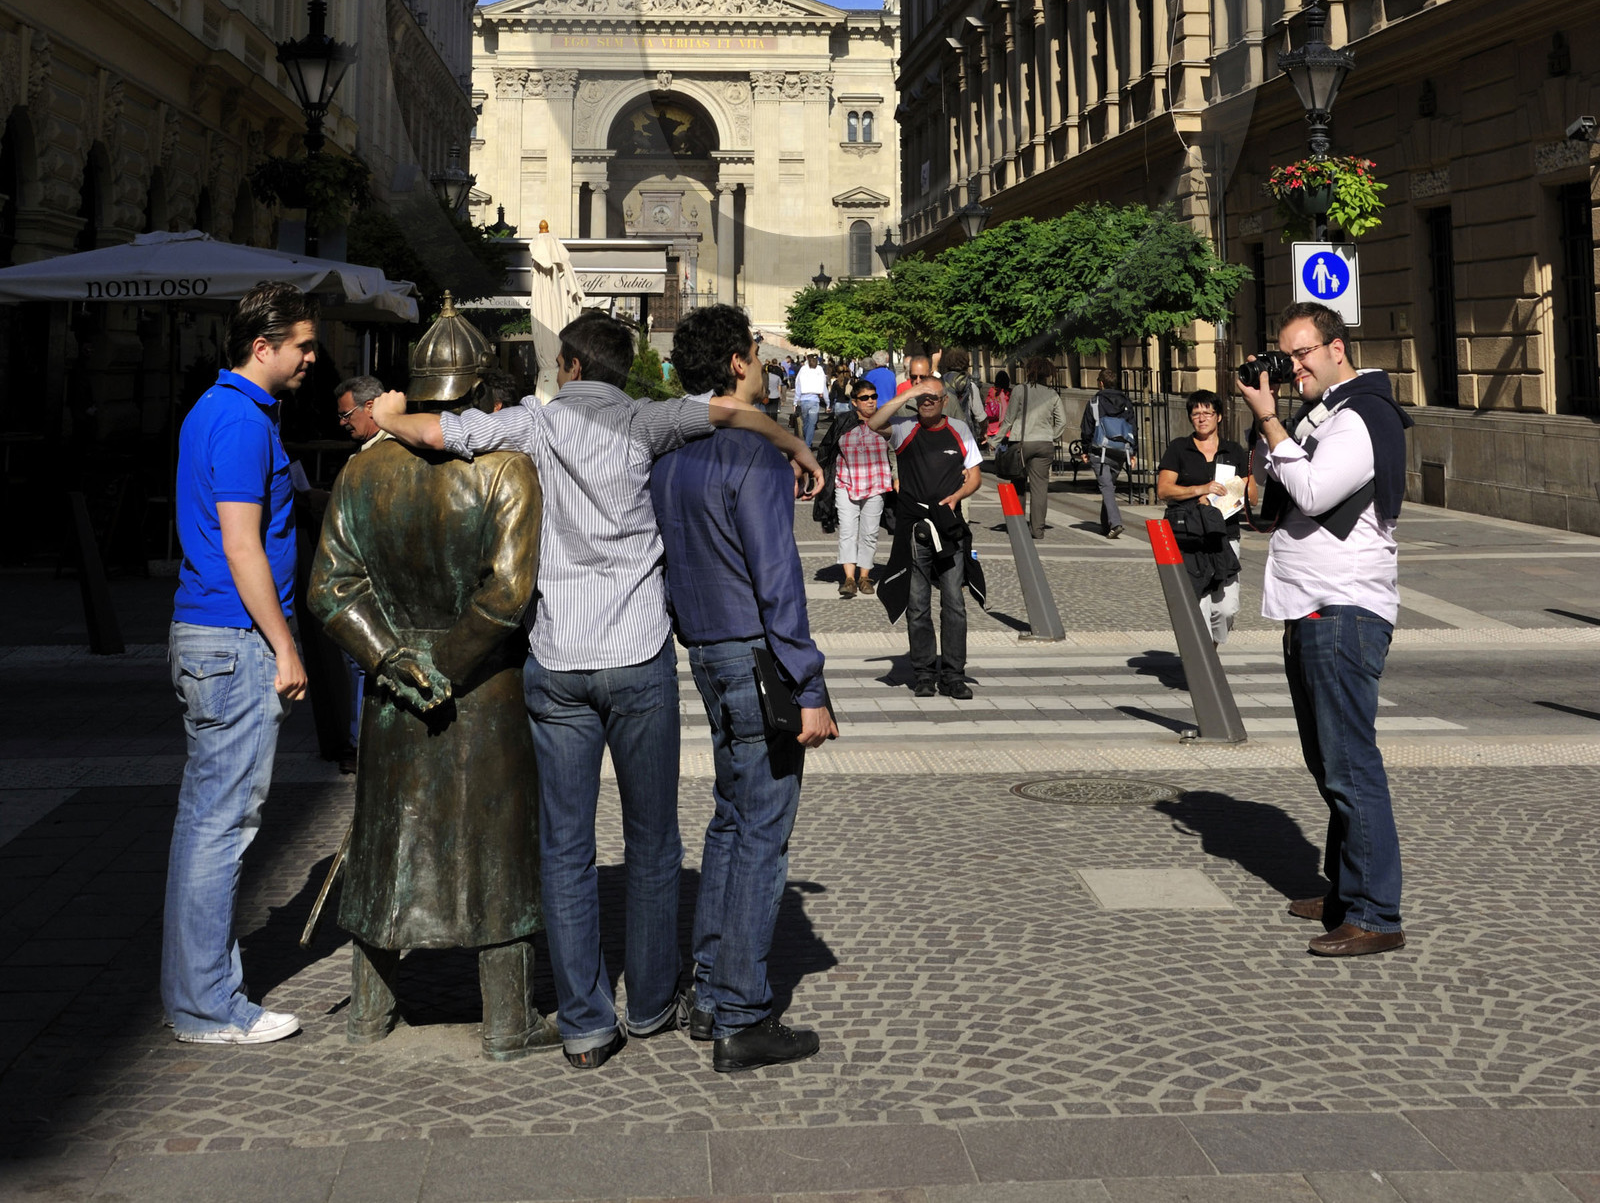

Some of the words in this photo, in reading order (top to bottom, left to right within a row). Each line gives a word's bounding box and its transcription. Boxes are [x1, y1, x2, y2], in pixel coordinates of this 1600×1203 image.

[564, 37, 589, 47] EGO
[597, 37, 623, 48] SUM
[632, 37, 654, 48] VIA
[661, 38, 710, 48] VERITAS
[717, 38, 731, 49] ET
[739, 39, 765, 49] VITA
[614, 275, 652, 289] Subito
